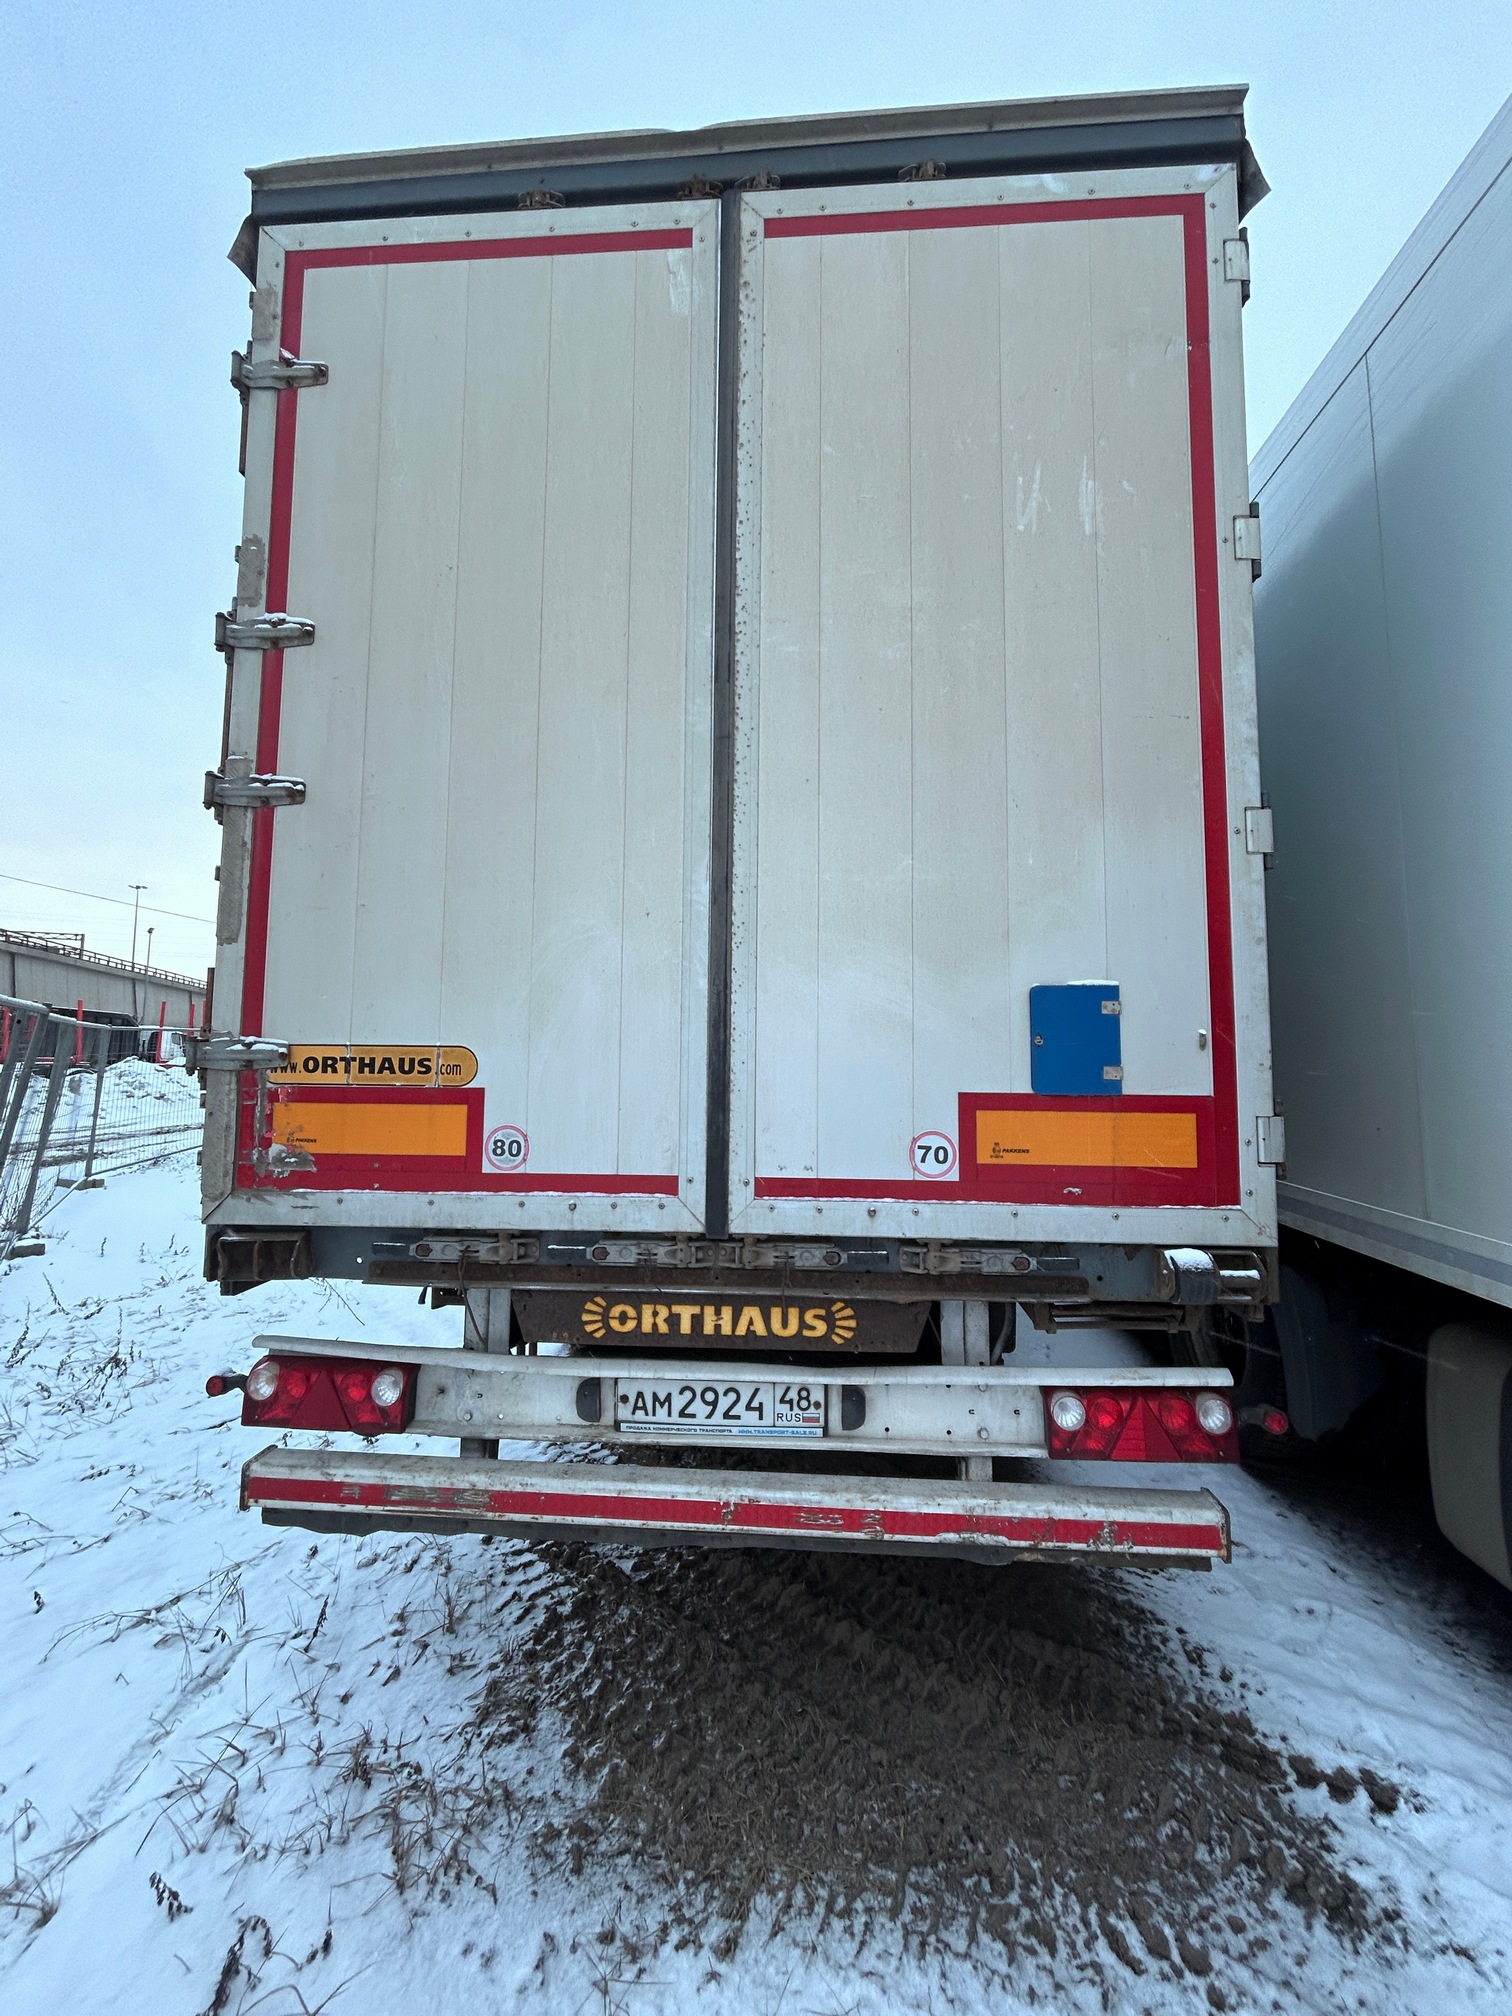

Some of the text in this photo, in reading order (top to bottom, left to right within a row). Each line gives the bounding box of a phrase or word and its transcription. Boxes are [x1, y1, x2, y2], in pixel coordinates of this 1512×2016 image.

[492, 1139, 522, 1158] 80
[917, 1145, 949, 1165] 70
[608, 1303, 828, 1338] ORTHAUS
[779, 1386, 812, 1412] 48
[776, 1412, 802, 1423] RUS
